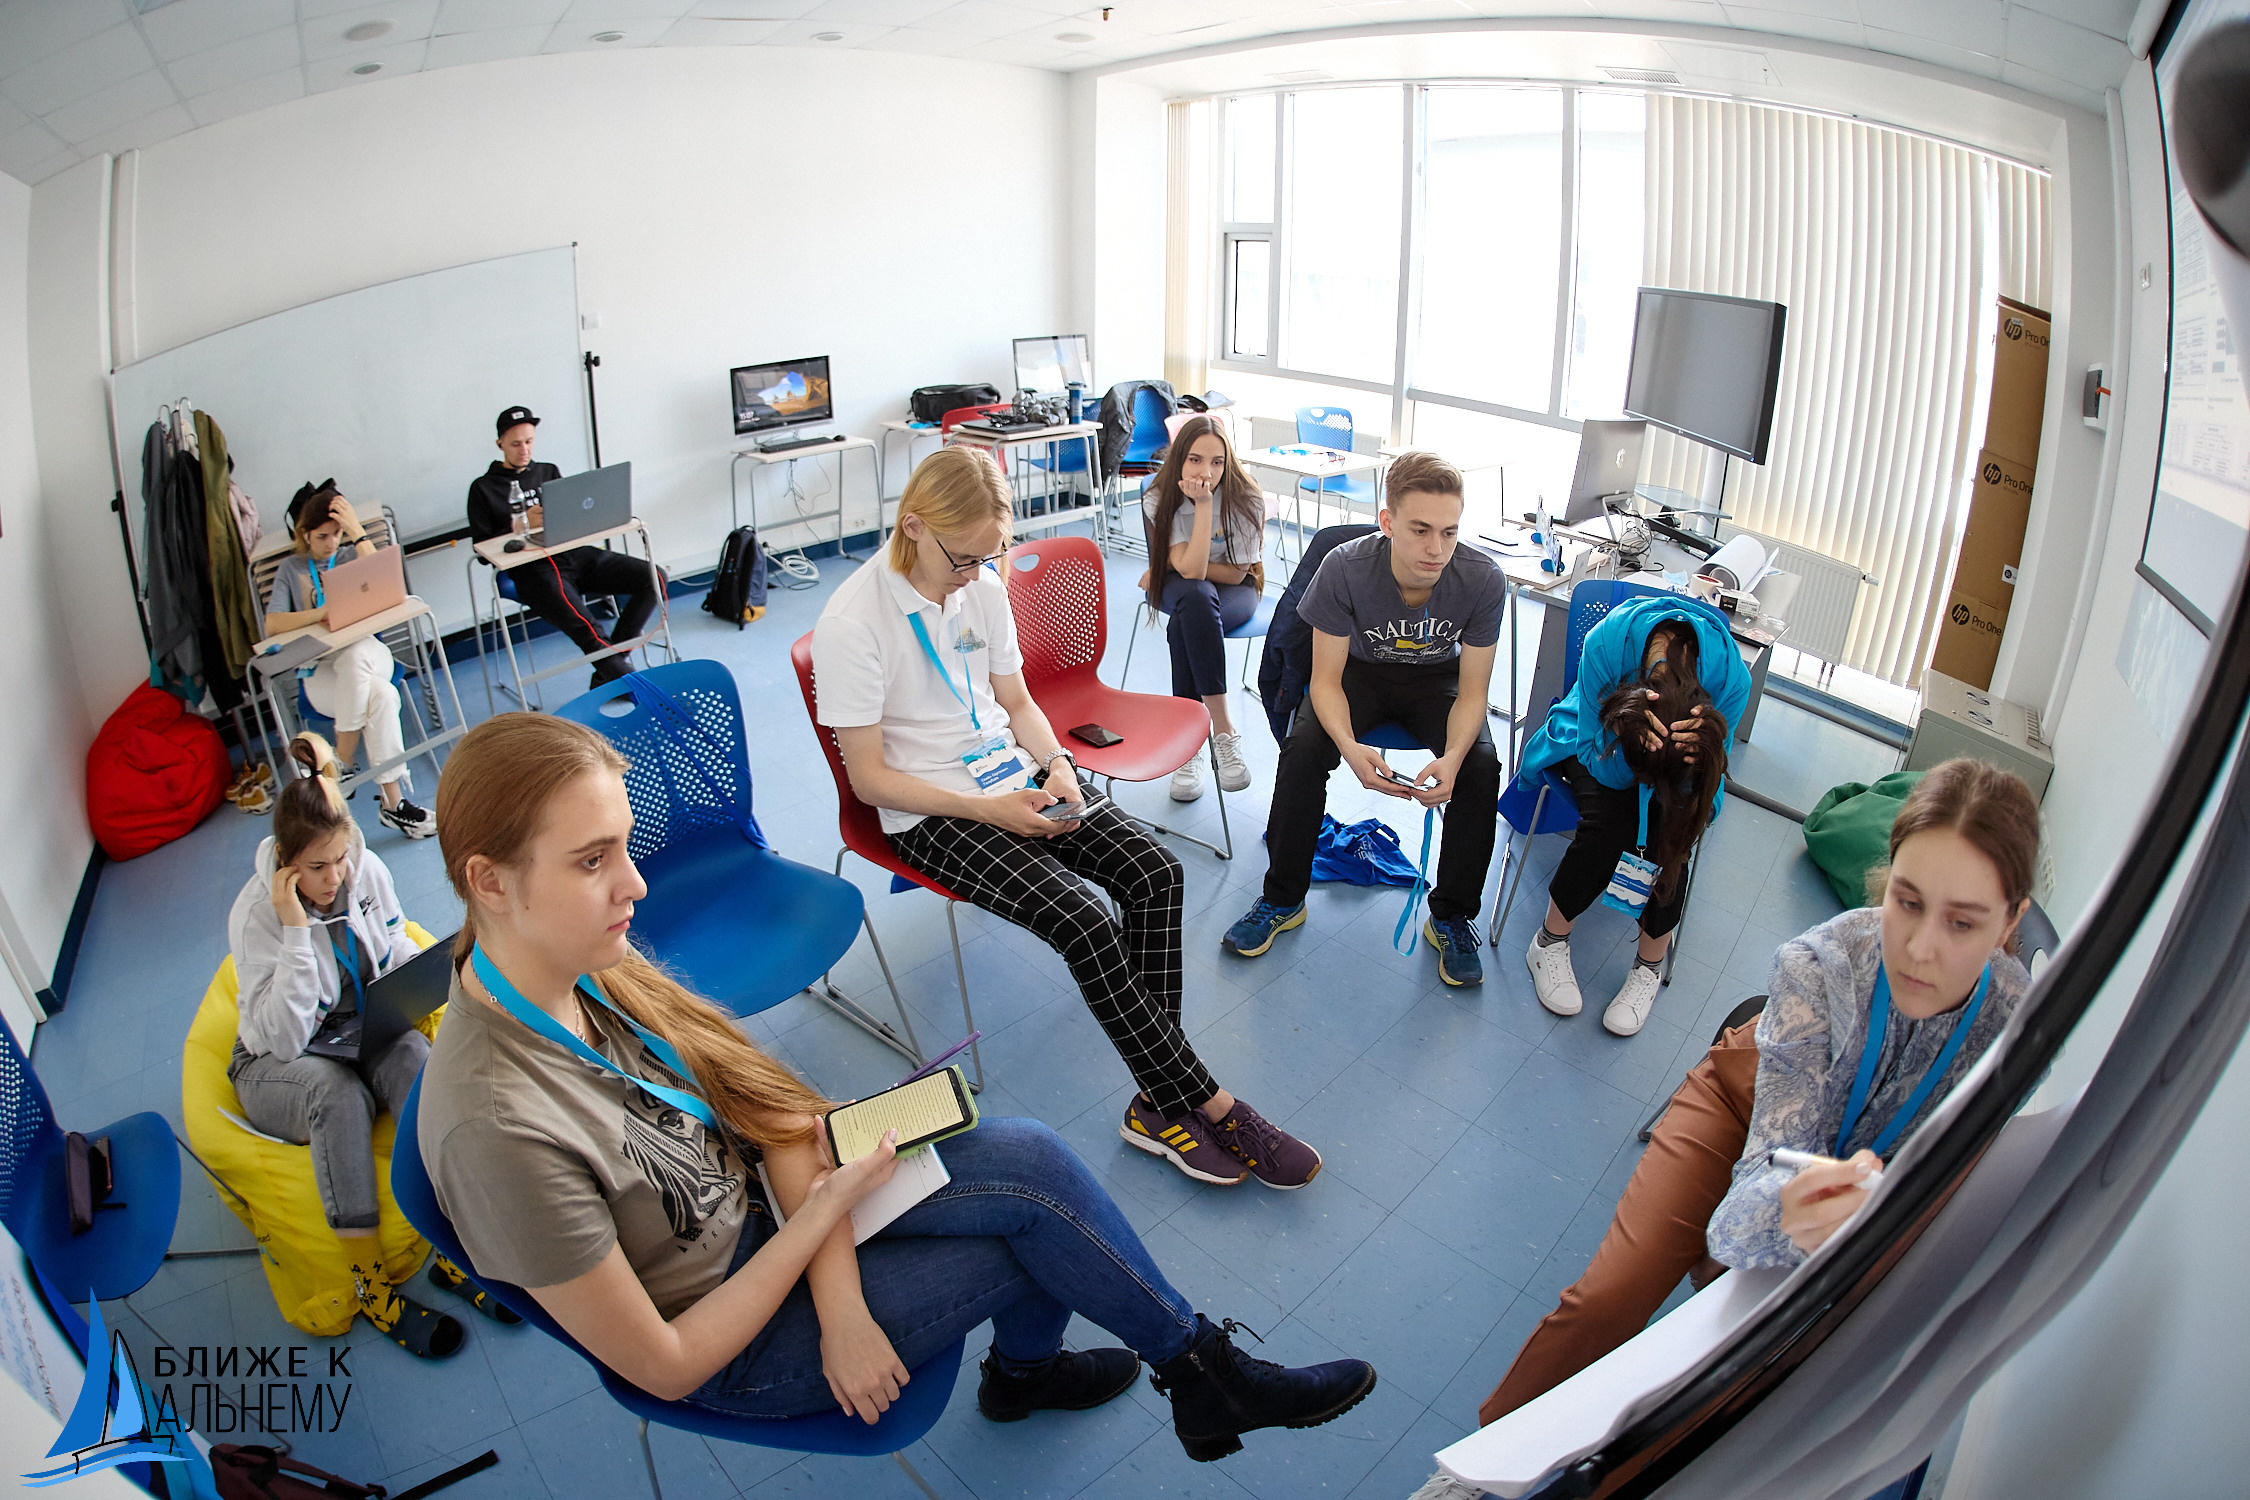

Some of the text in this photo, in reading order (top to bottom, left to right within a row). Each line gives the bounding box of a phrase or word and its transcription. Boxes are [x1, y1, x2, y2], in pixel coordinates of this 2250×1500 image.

[2003, 318, 2022, 340] hp
[1983, 462, 2002, 485] hp
[1952, 603, 1970, 626] hp
[1363, 617, 1463, 643] NAUTICA
